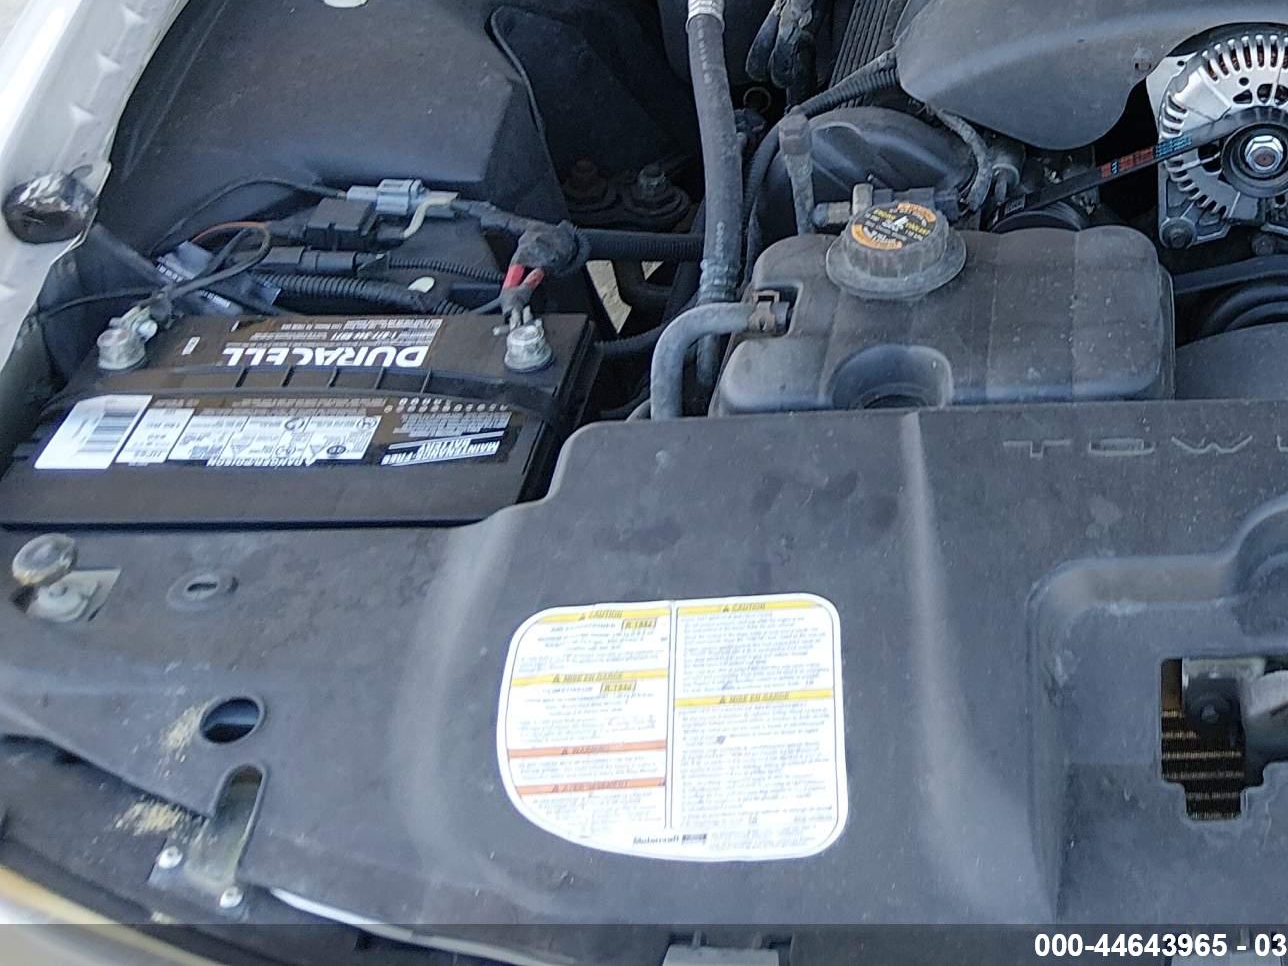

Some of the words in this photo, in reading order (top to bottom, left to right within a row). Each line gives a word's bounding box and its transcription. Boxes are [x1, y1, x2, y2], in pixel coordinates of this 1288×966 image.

[222, 345, 429, 367] DURACELL
[732, 602, 767, 611] CAUTION
[588, 609, 624, 619] CAUTION
[633, 834, 679, 845] Motorcraft
